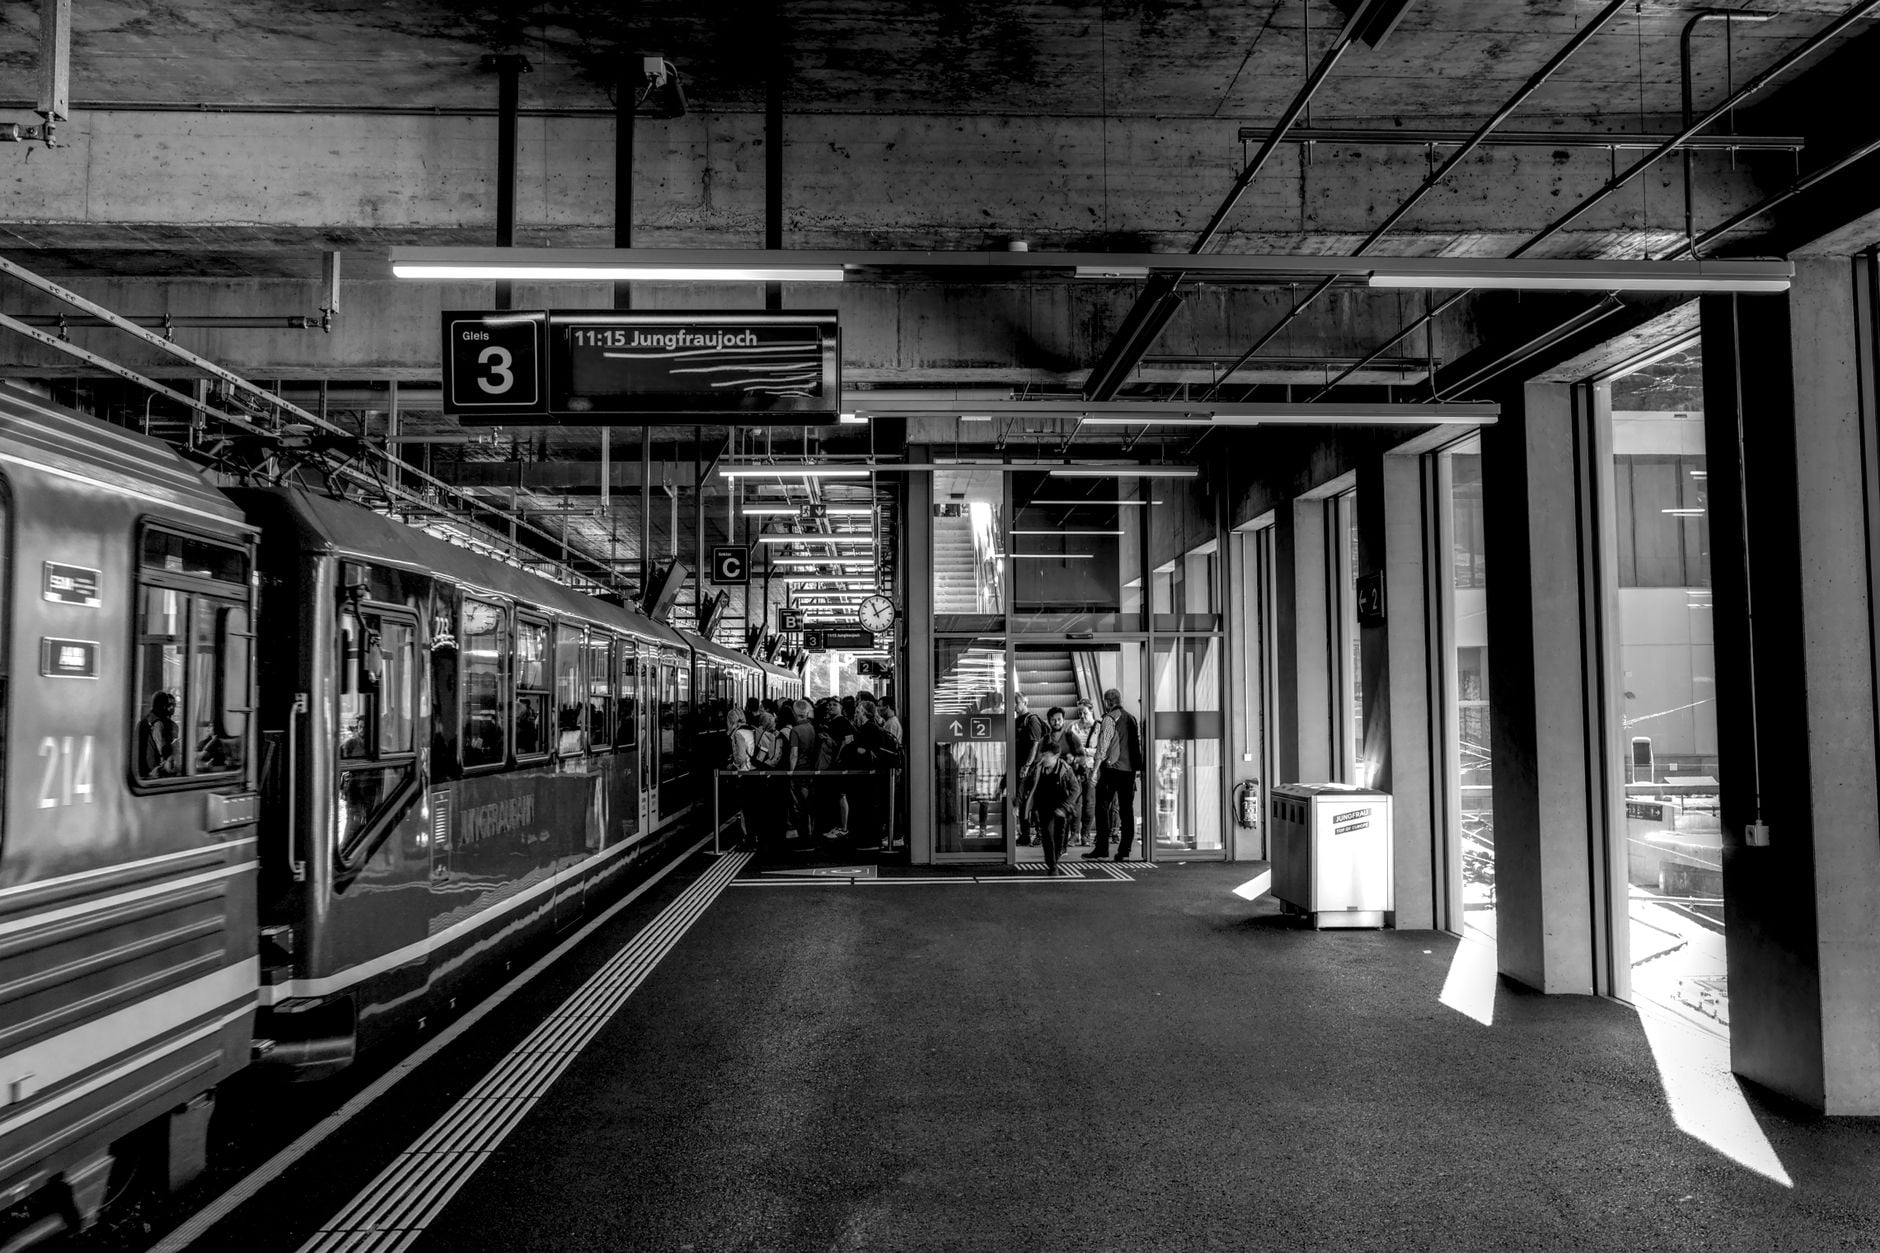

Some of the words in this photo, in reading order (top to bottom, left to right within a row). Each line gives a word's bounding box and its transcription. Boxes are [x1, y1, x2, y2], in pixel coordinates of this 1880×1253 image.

[462, 330, 490, 341] Gleis
[574, 330, 626, 347] 11:15
[630, 329, 758, 350] Jungfraujoch
[477, 346, 514, 394] 3
[722, 557, 741, 578] C
[1372, 588, 1378, 609] 2
[785, 616, 797, 629] B
[809, 636, 817, 646] 3
[862, 663, 870, 673] 2
[976, 723, 986, 736] 2
[37, 734, 96, 808] 214
[1336, 810, 1368, 823] JUNGFRAU
[1352, 822, 1369, 831] EUROPE
